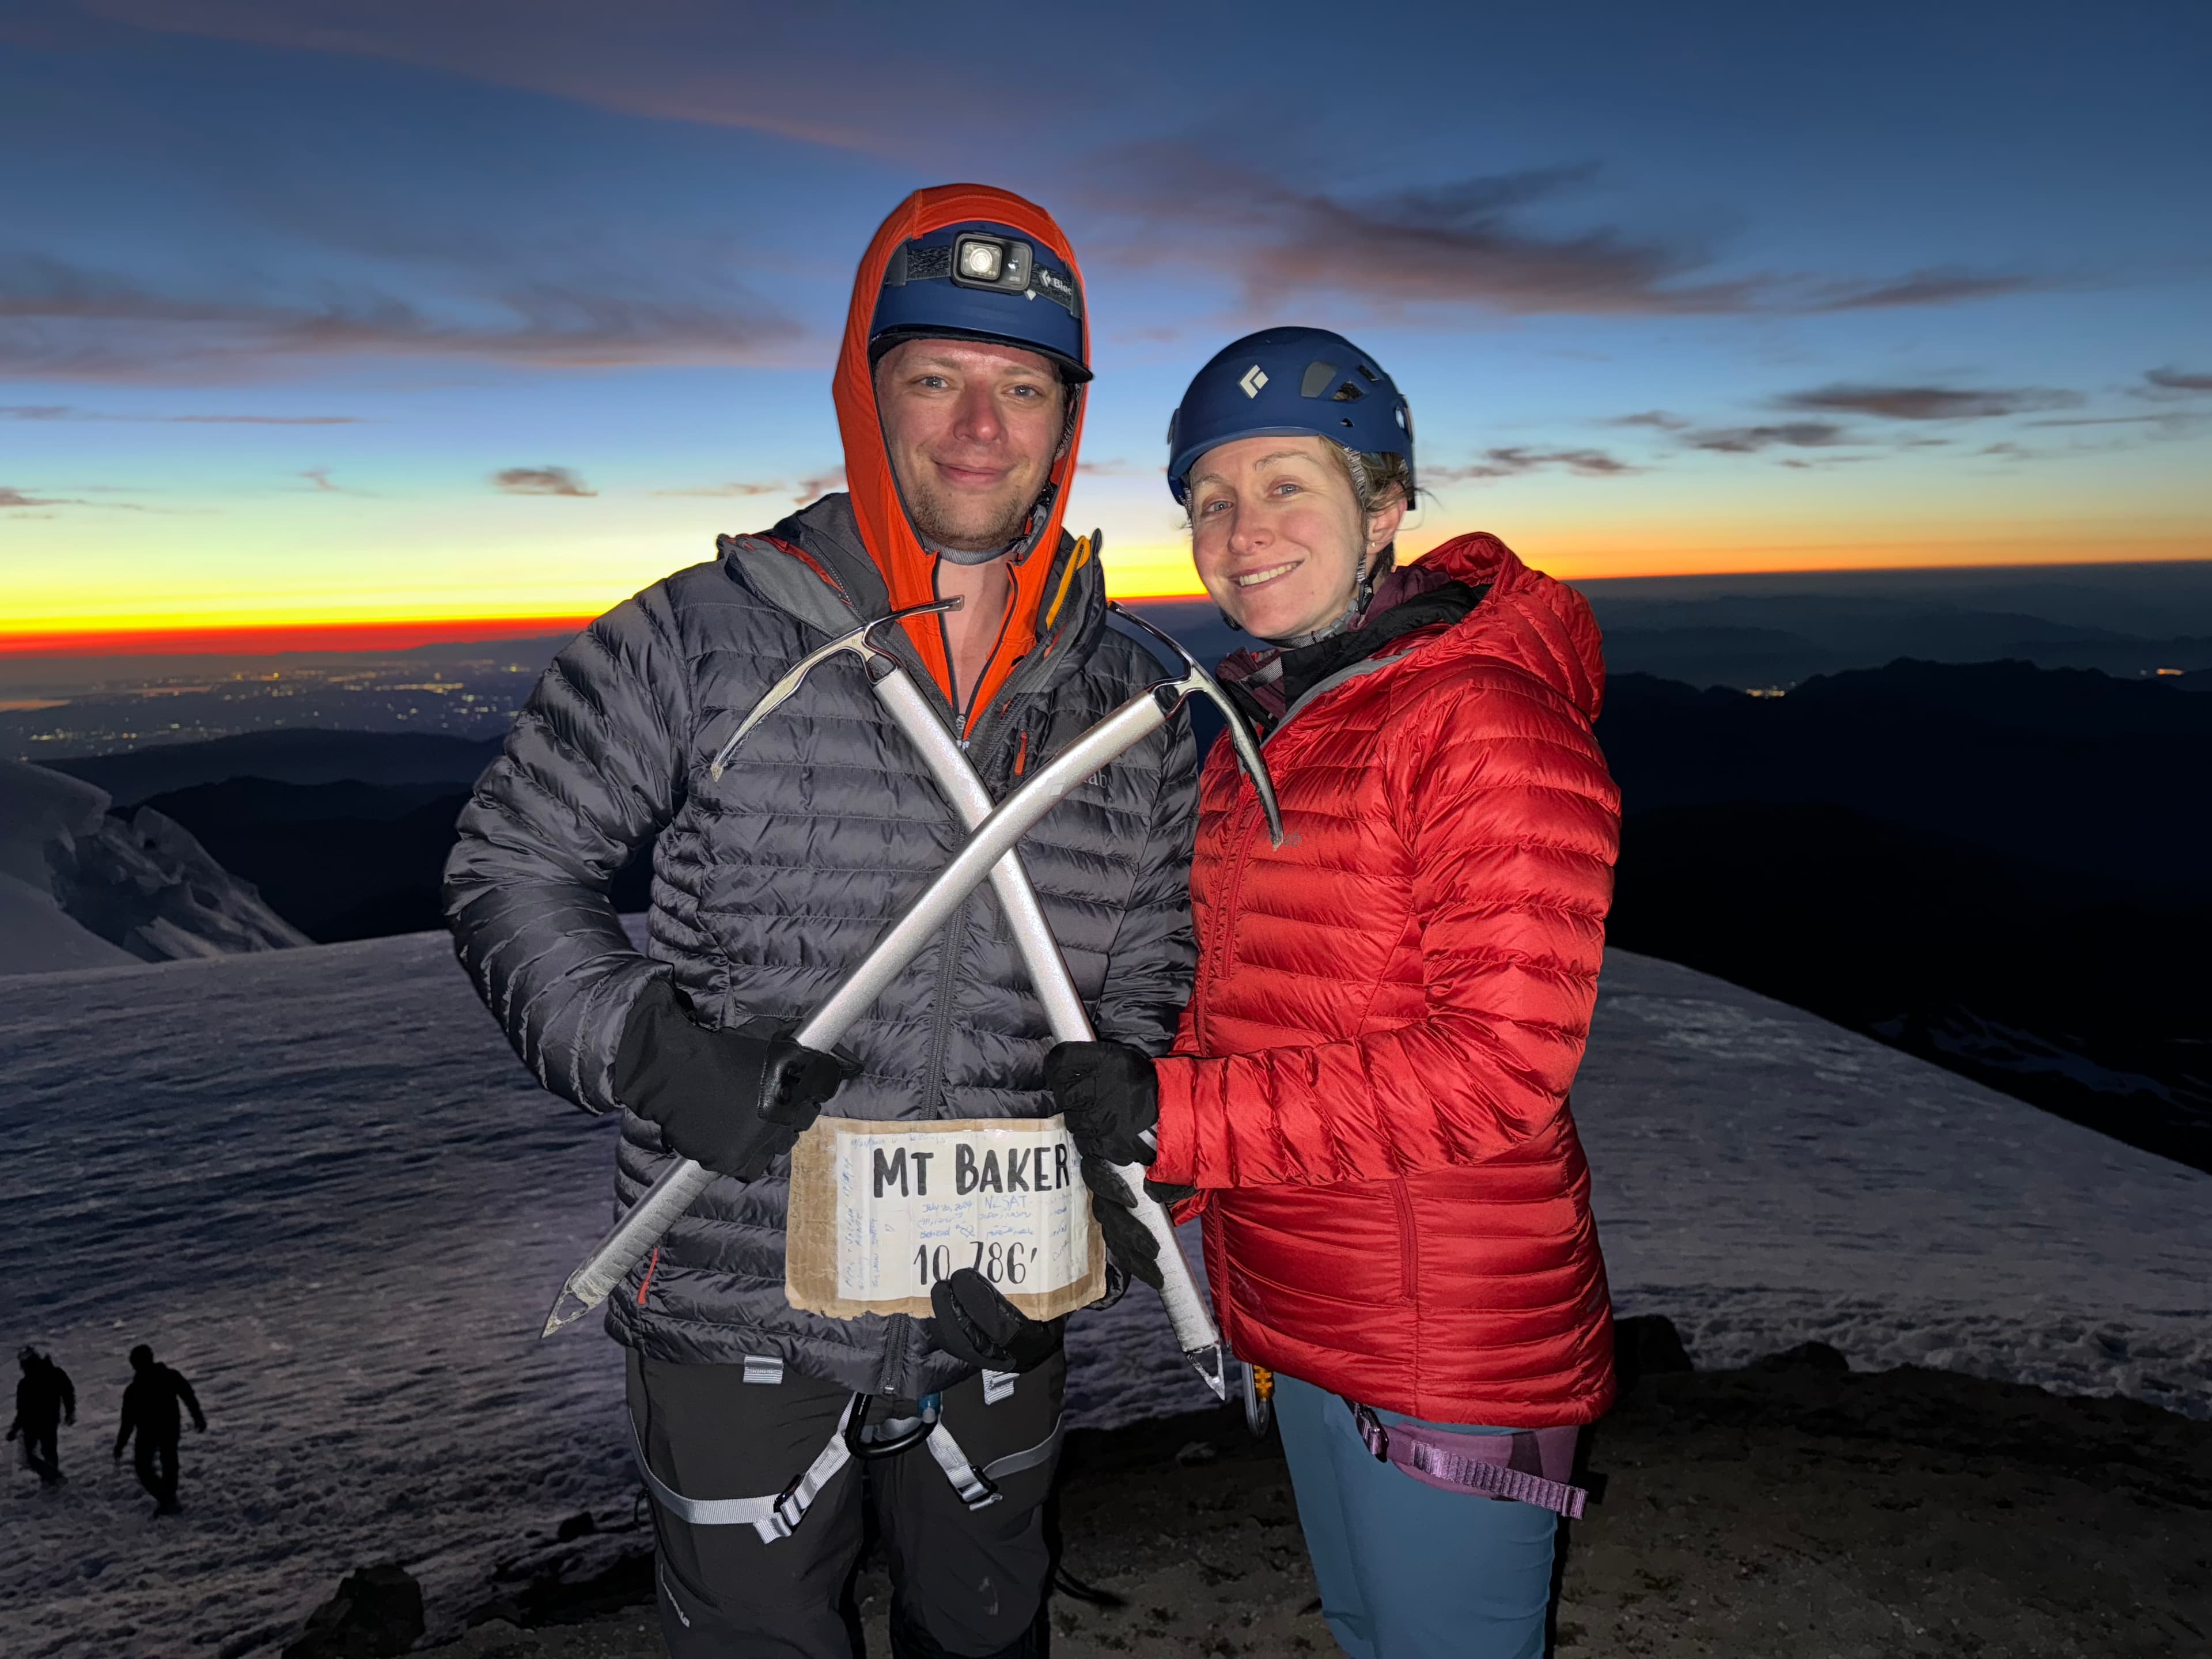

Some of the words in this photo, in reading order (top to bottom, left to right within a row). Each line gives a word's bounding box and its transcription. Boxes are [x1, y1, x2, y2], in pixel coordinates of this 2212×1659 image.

[1084, 769, 1107, 789] ab
[873, 1147, 934, 1198] MT
[956, 1143, 1070, 1195] BAKER
